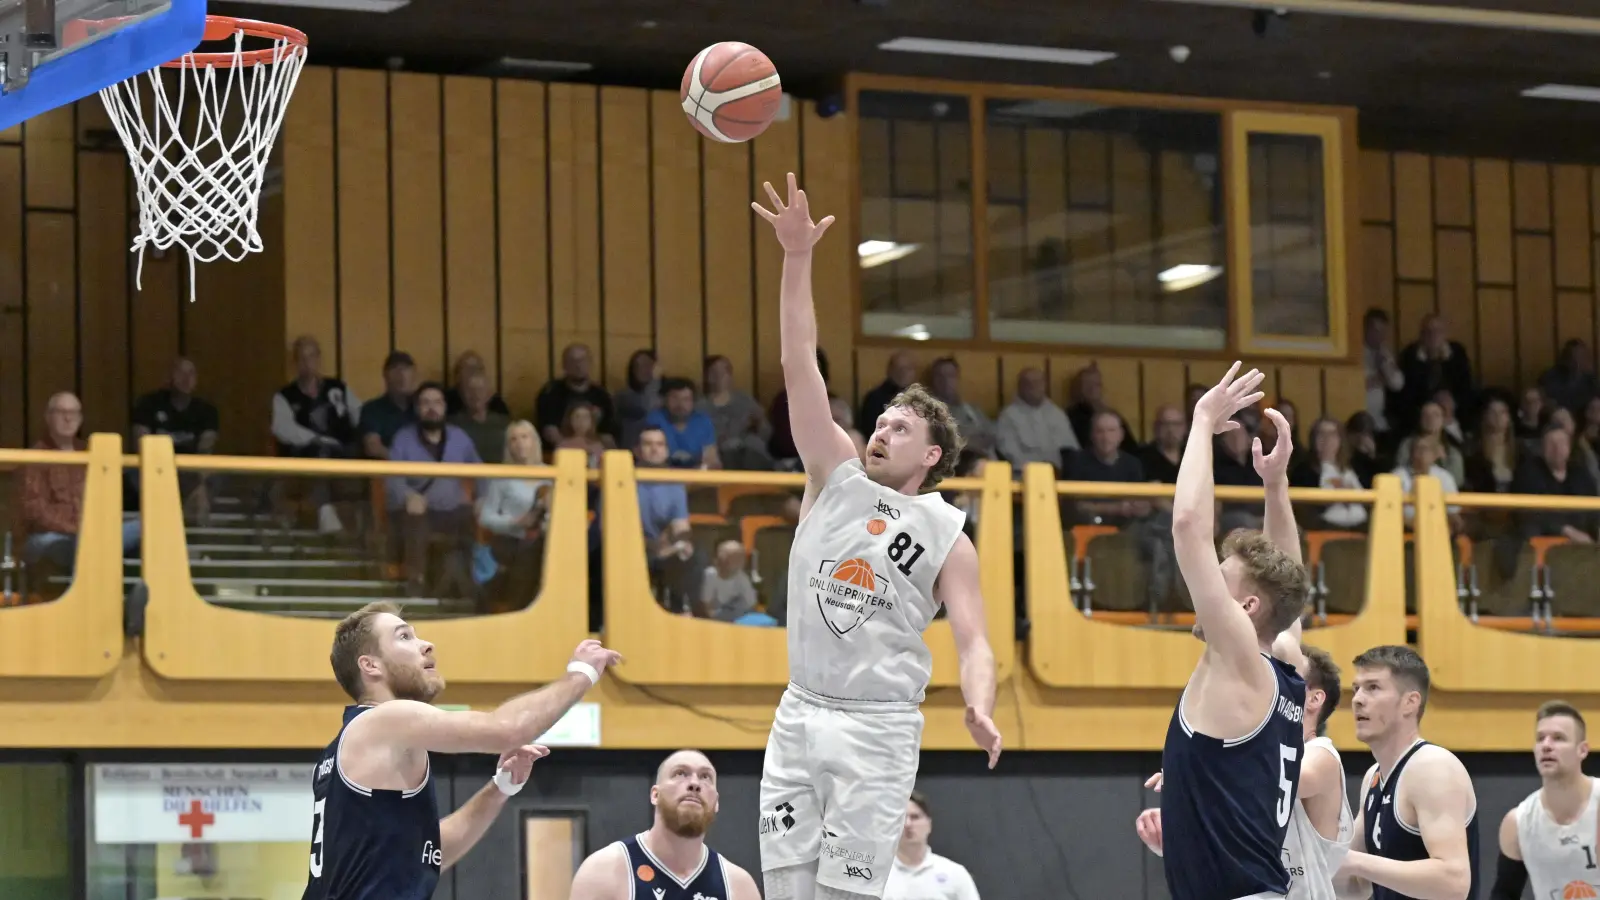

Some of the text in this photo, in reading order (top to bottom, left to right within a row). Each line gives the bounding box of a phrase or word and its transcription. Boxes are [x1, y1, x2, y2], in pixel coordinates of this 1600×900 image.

[887, 531, 926, 577] 81
[809, 576, 894, 611] ONLINEPRINTERS
[163, 786, 249, 797] MENSCHEN
[1276, 743, 1297, 828] 5
[203, 798, 262, 813] HELFEN
[309, 797, 327, 878] 3
[1285, 866, 1305, 876] RS
